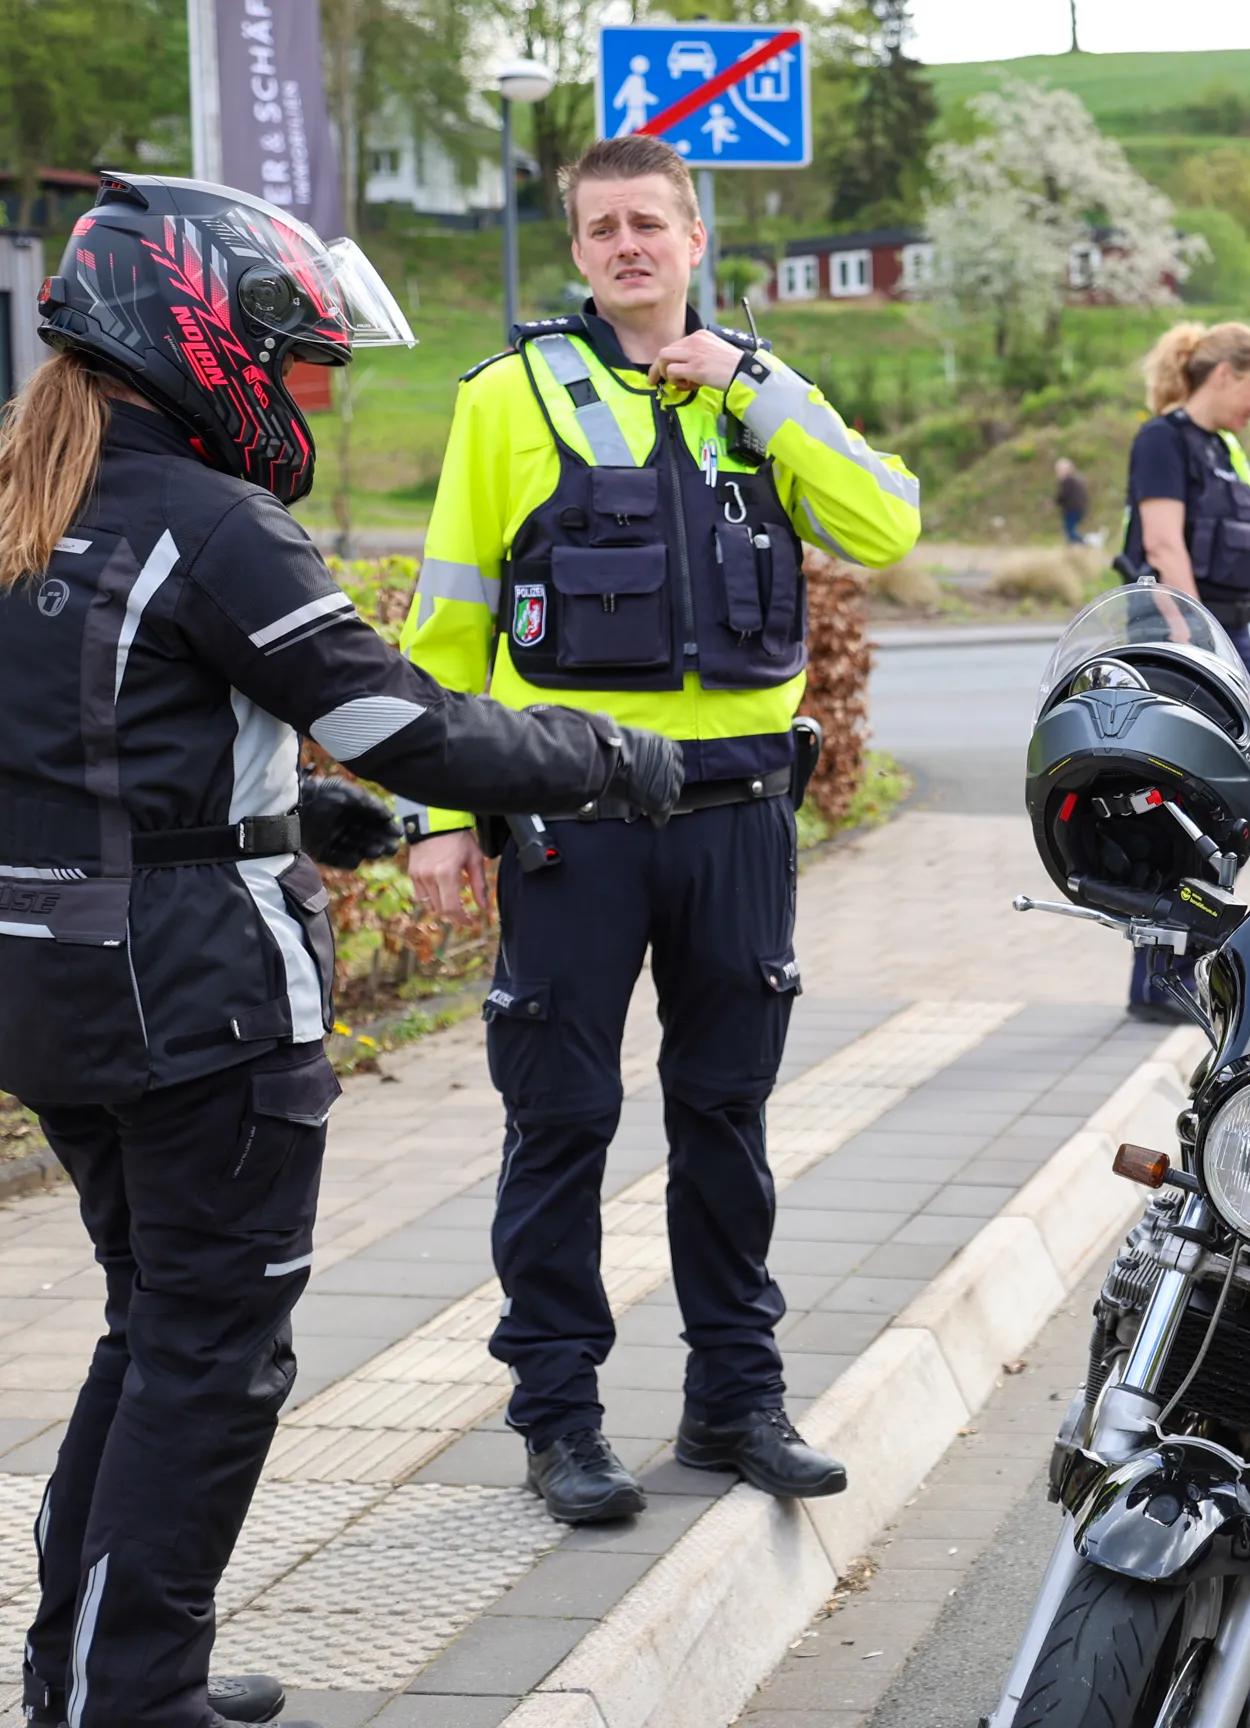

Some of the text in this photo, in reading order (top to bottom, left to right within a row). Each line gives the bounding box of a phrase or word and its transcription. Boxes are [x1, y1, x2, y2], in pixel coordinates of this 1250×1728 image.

[259, 129, 286, 153] &
[261, 159, 293, 208] ER
[170, 306, 229, 392] NOLAN
